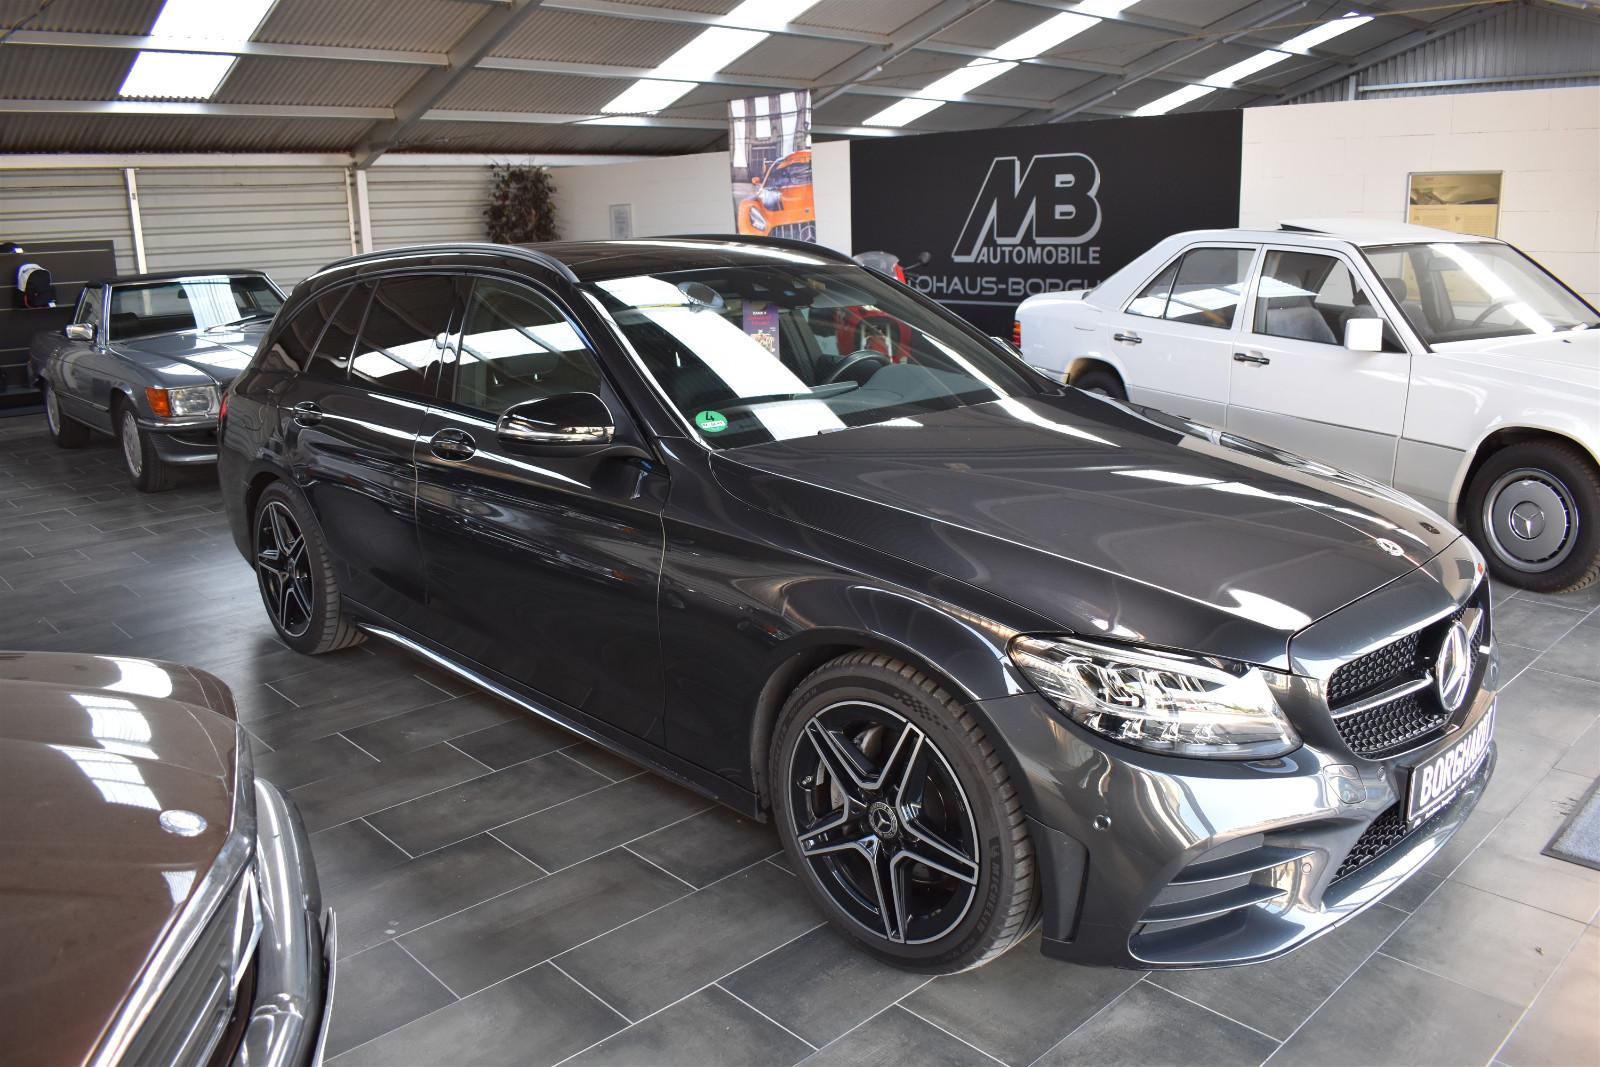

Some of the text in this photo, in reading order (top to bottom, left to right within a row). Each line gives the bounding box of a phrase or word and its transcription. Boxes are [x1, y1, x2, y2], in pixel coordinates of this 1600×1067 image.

[951, 152, 1102, 263] MB
[976, 246, 1100, 264] AUTOMOBILE
[705, 411, 715, 421] 4
